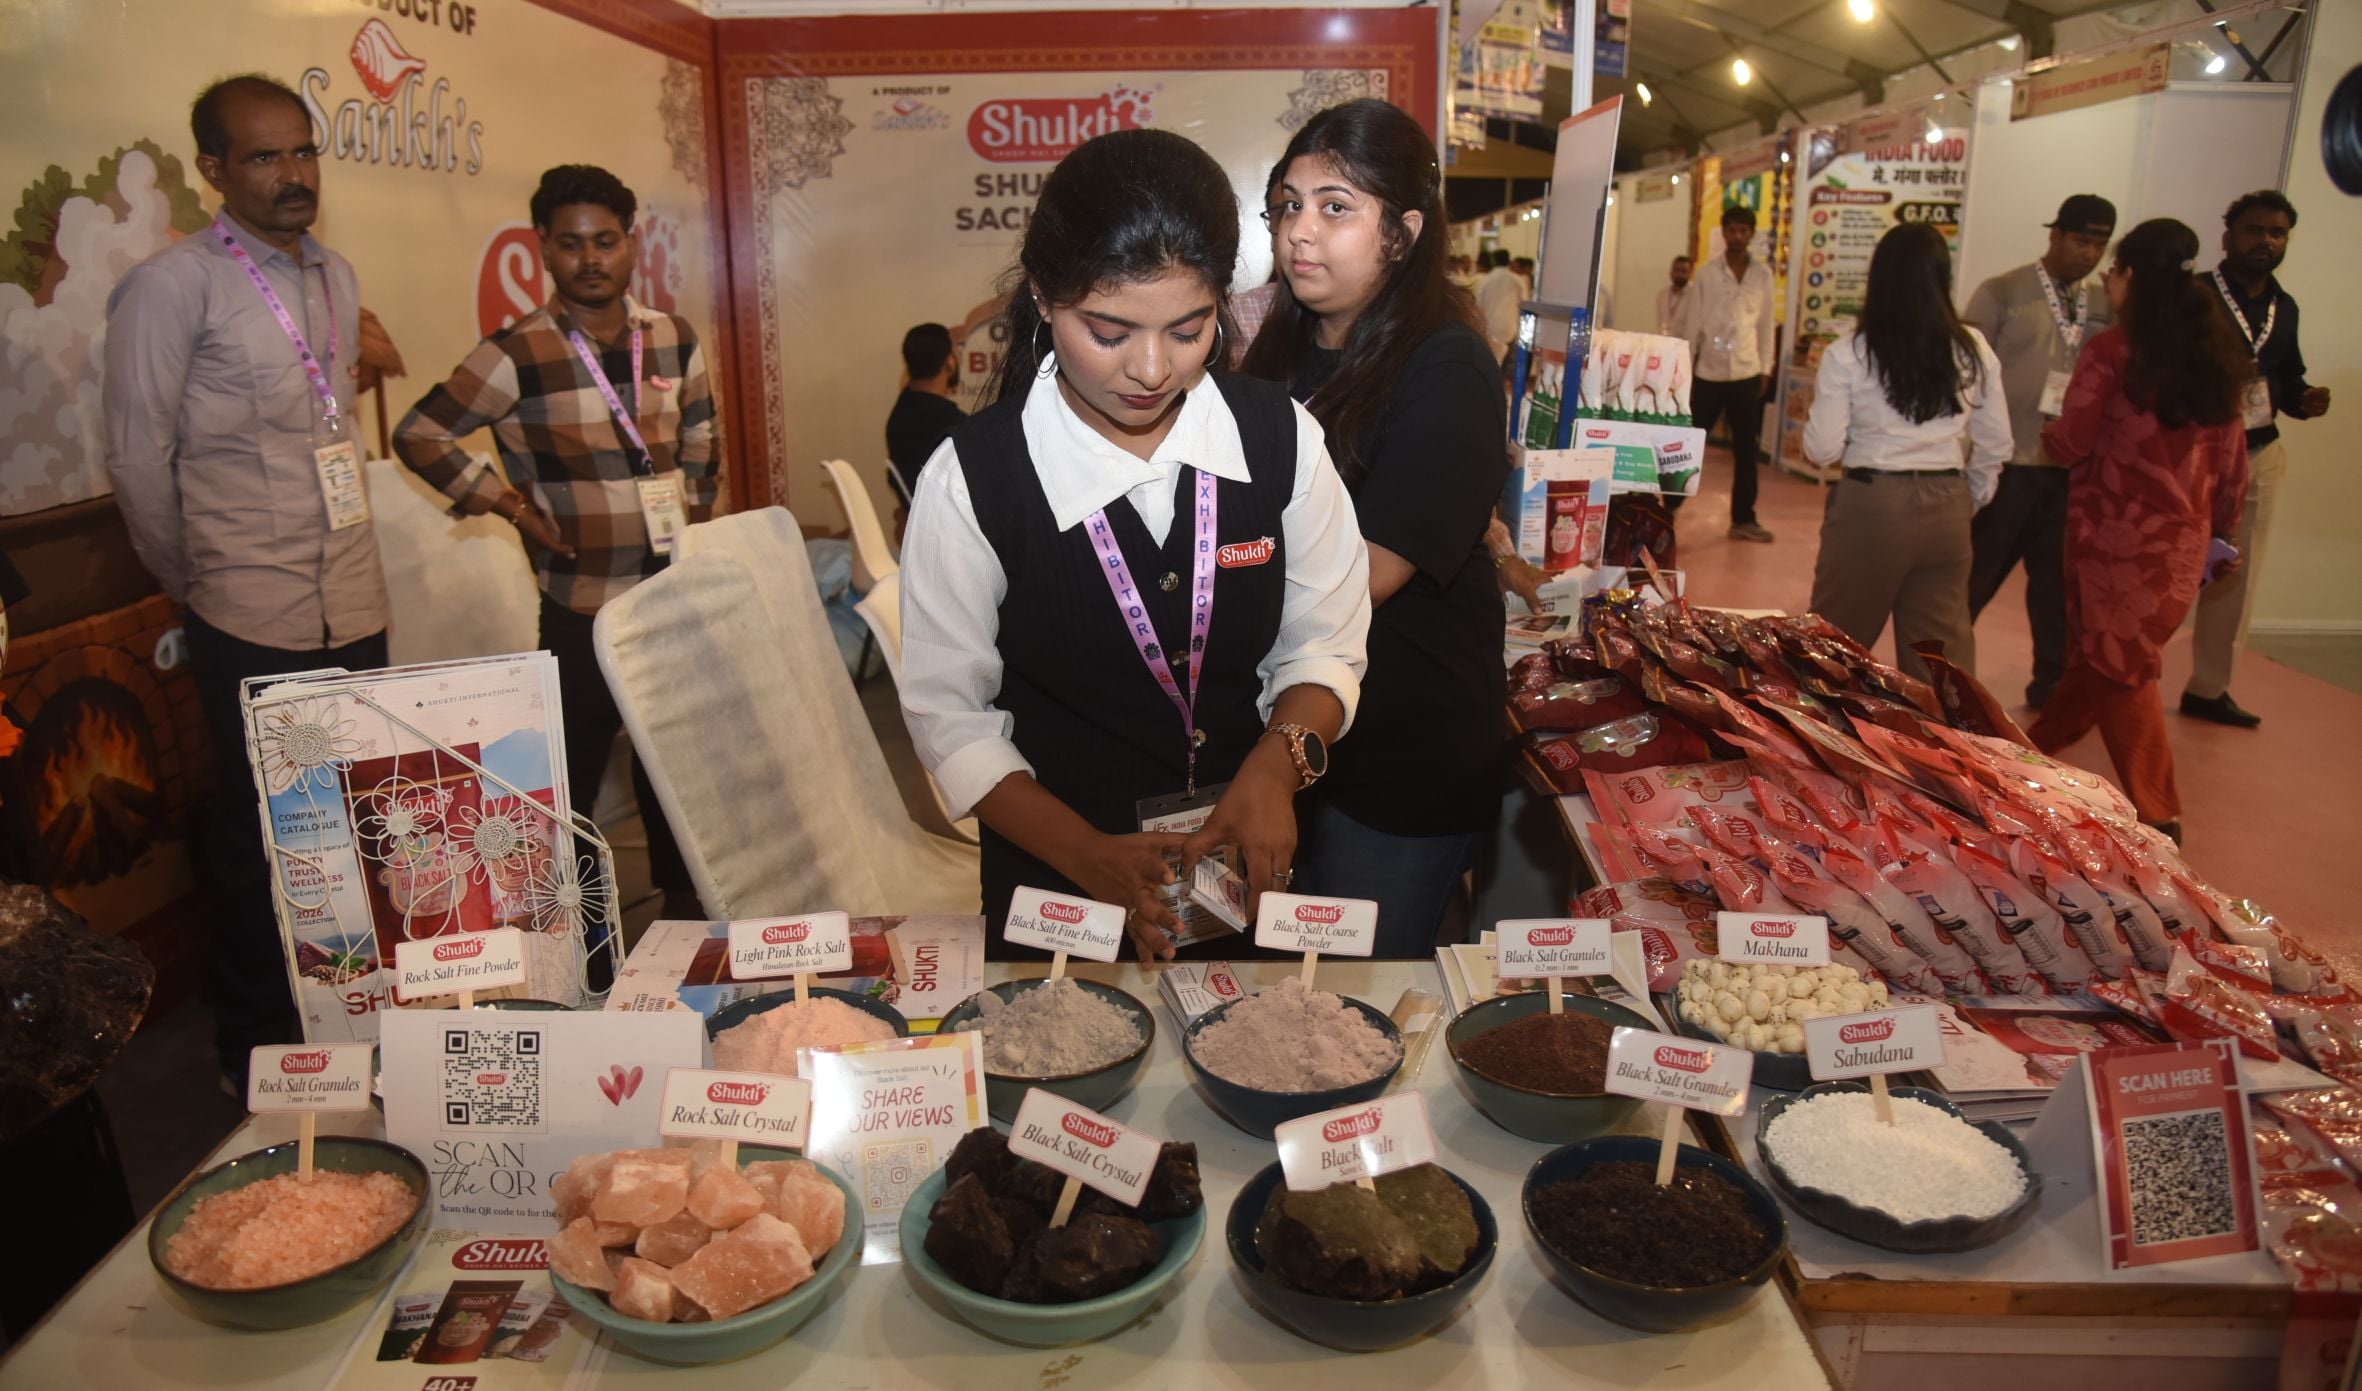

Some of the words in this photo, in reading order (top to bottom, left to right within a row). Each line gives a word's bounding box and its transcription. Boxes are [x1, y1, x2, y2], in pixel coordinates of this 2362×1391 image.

[450, 2, 476, 35] OF
[883, 86, 933, 96] PRODUCT
[937, 85, 950, 95] OF
[301, 67, 484, 176] Sankh's
[1918, 137, 1965, 162] FOOD
[1816, 191, 1837, 203] Key
[1839, 191, 1885, 202] Features
[1196, 471, 1211, 626] EXHIBITOR
[1221, 545, 1266, 563] Shukti
[428, 697, 457, 706] SHUKTI
[459, 688, 520, 703] INTERNATIONAL
[1171, 821, 1187, 831] INDIA
[1187, 817, 1202, 828] FOOD
[299, 889, 319, 898] Every
[295, 908, 324, 919] 2026
[1043, 902, 1080, 921] Shukti
[1298, 905, 1337, 920] Shukti
[296, 916, 336, 927] COLLECTION
[1009, 914, 1038, 931] Black
[1037, 920, 1057, 935] Salt
[1058, 924, 1081, 939] Fine
[1082, 929, 1119, 947] Powder
[1272, 920, 1304, 934] Black
[1303, 922, 1323, 935] Salt
[1325, 924, 1359, 938] Coarse
[1754, 922, 1790, 935] Shukti
[765, 926, 805, 941] Shukti
[1296, 936, 1333, 949] Powder
[1531, 930, 1569, 943] Shukti
[436, 941, 479, 958] Shukti
[735, 947, 764, 965] Light
[767, 944, 793, 960] Pink
[795, 942, 822, 957] Rock
[824, 939, 846, 954] Salt
[1056, 939, 1076, 948] micron
[1743, 940, 1809, 958] Makhana
[1504, 950, 1534, 964] Black
[1536, 949, 1558, 962] Salt
[1559, 947, 1606, 962] Granules
[404, 970, 431, 985] Rock
[433, 966, 455, 981] Salt
[457, 963, 481, 977] Fine
[483, 957, 521, 973] Powder
[762, 960, 795, 971] Himalayan
[795, 959, 810, 967] Rock
[911, 945, 940, 992] SHUKTI
[1534, 964, 1546, 972] 0.2
[1842, 1022, 1888, 1041] Shukti
[284, 1055, 323, 1069] Shukti
[1658, 1047, 1704, 1069] Shukti
[1833, 1044, 1915, 1069] Sabudana
[900, 1065, 920, 1073] about
[258, 1078, 282, 1094] Rock
[285, 1077, 305, 1093] Salt
[308, 1076, 361, 1092] Granules
[479, 1075, 503, 1083] Shukti
[1616, 1061, 1652, 1082] Black
[1654, 1069, 1682, 1088] Salt
[1683, 1075, 1740, 1098] Granules
[2119, 1073, 2167, 1094] SCAN
[2170, 1067, 2214, 1088] HERE
[286, 1095, 291, 1103] 2
[711, 1083, 759, 1101] Shukti
[861, 1086, 925, 1110] SHARE
[1654, 1086, 1661, 1094] 2
[671, 1105, 709, 1124] Rock
[710, 1107, 741, 1127] Salt
[743, 1111, 798, 1133] Crystal
[895, 1105, 955, 1129] VIEWS
[1065, 1113, 1111, 1144] Shukti
[1327, 1116, 1375, 1138] Shukti
[433, 1140, 525, 1168] SCAN
[1022, 1124, 1061, 1151] Black
[1063, 1141, 1092, 1165] Salt
[1093, 1154, 1143, 1188] Crystal
[1321, 1143, 1361, 1169] Black
[432, 1163, 485, 1199] the
[490, 1169, 537, 1199] QR
[440, 1204, 461, 1213] Scan
[462, 1205, 477, 1214] the
[478, 1206, 493, 1216] QR
[493, 1208, 514, 1217] code
[516, 1209, 524, 1217] to
[528, 1208, 540, 1217] for
[542, 1209, 558, 1218] the
[462, 1242, 550, 1264] Shuk
[424, 1378, 472, 1391] 40+
